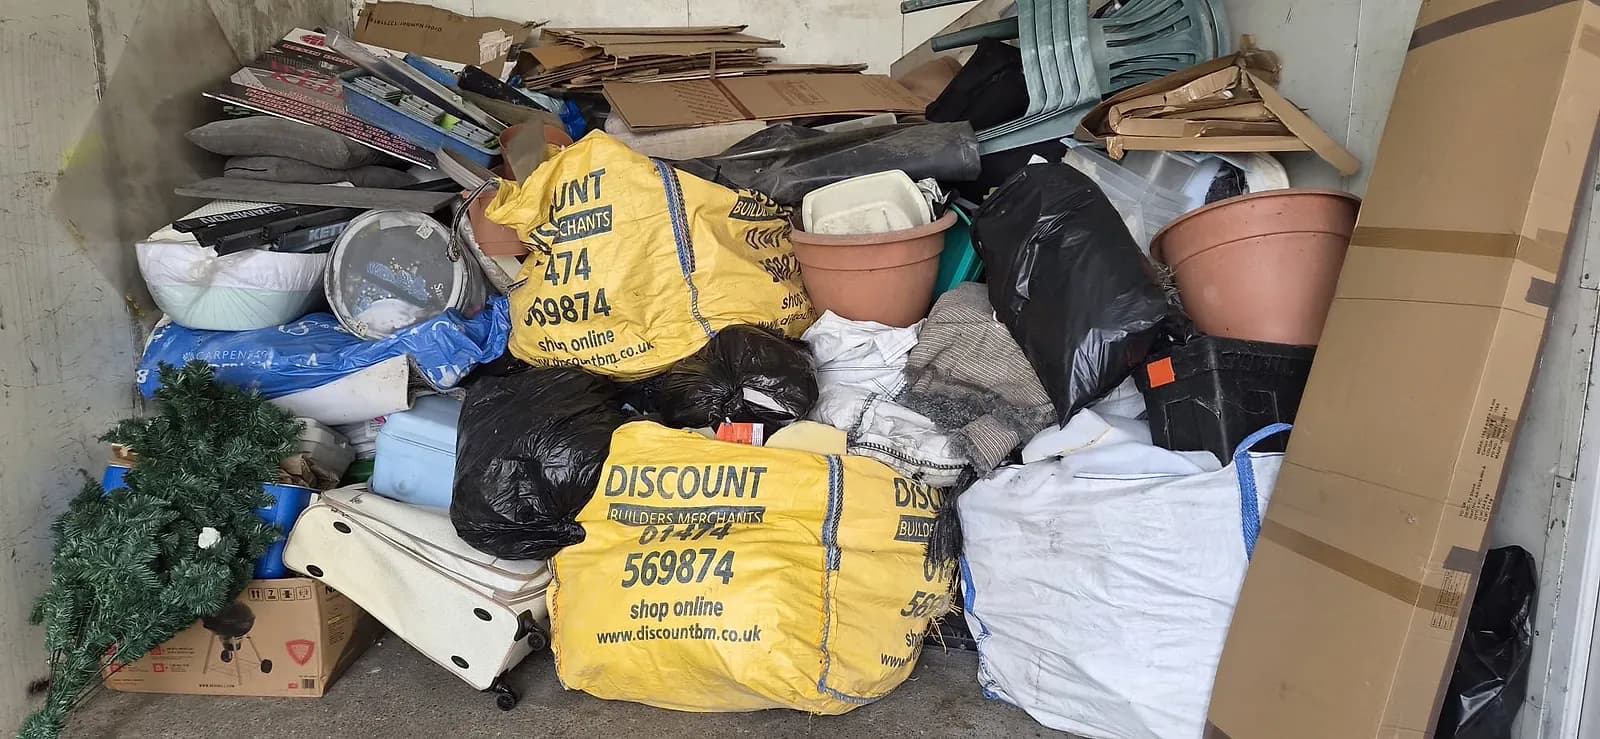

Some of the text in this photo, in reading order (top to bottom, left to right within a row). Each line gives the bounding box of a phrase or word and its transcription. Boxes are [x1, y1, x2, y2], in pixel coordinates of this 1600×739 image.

[544, 247, 592, 286] 474
[570, 329, 615, 352] online
[604, 465, 768, 500] DISCOUNT
[610, 508, 762, 525] BUILDERS MERCHANTS
[638, 521, 734, 546] 01474
[621, 548, 736, 588] 569874
[630, 596, 724, 622] shop online
[596, 623, 763, 645] www.discountbm.co.uk
